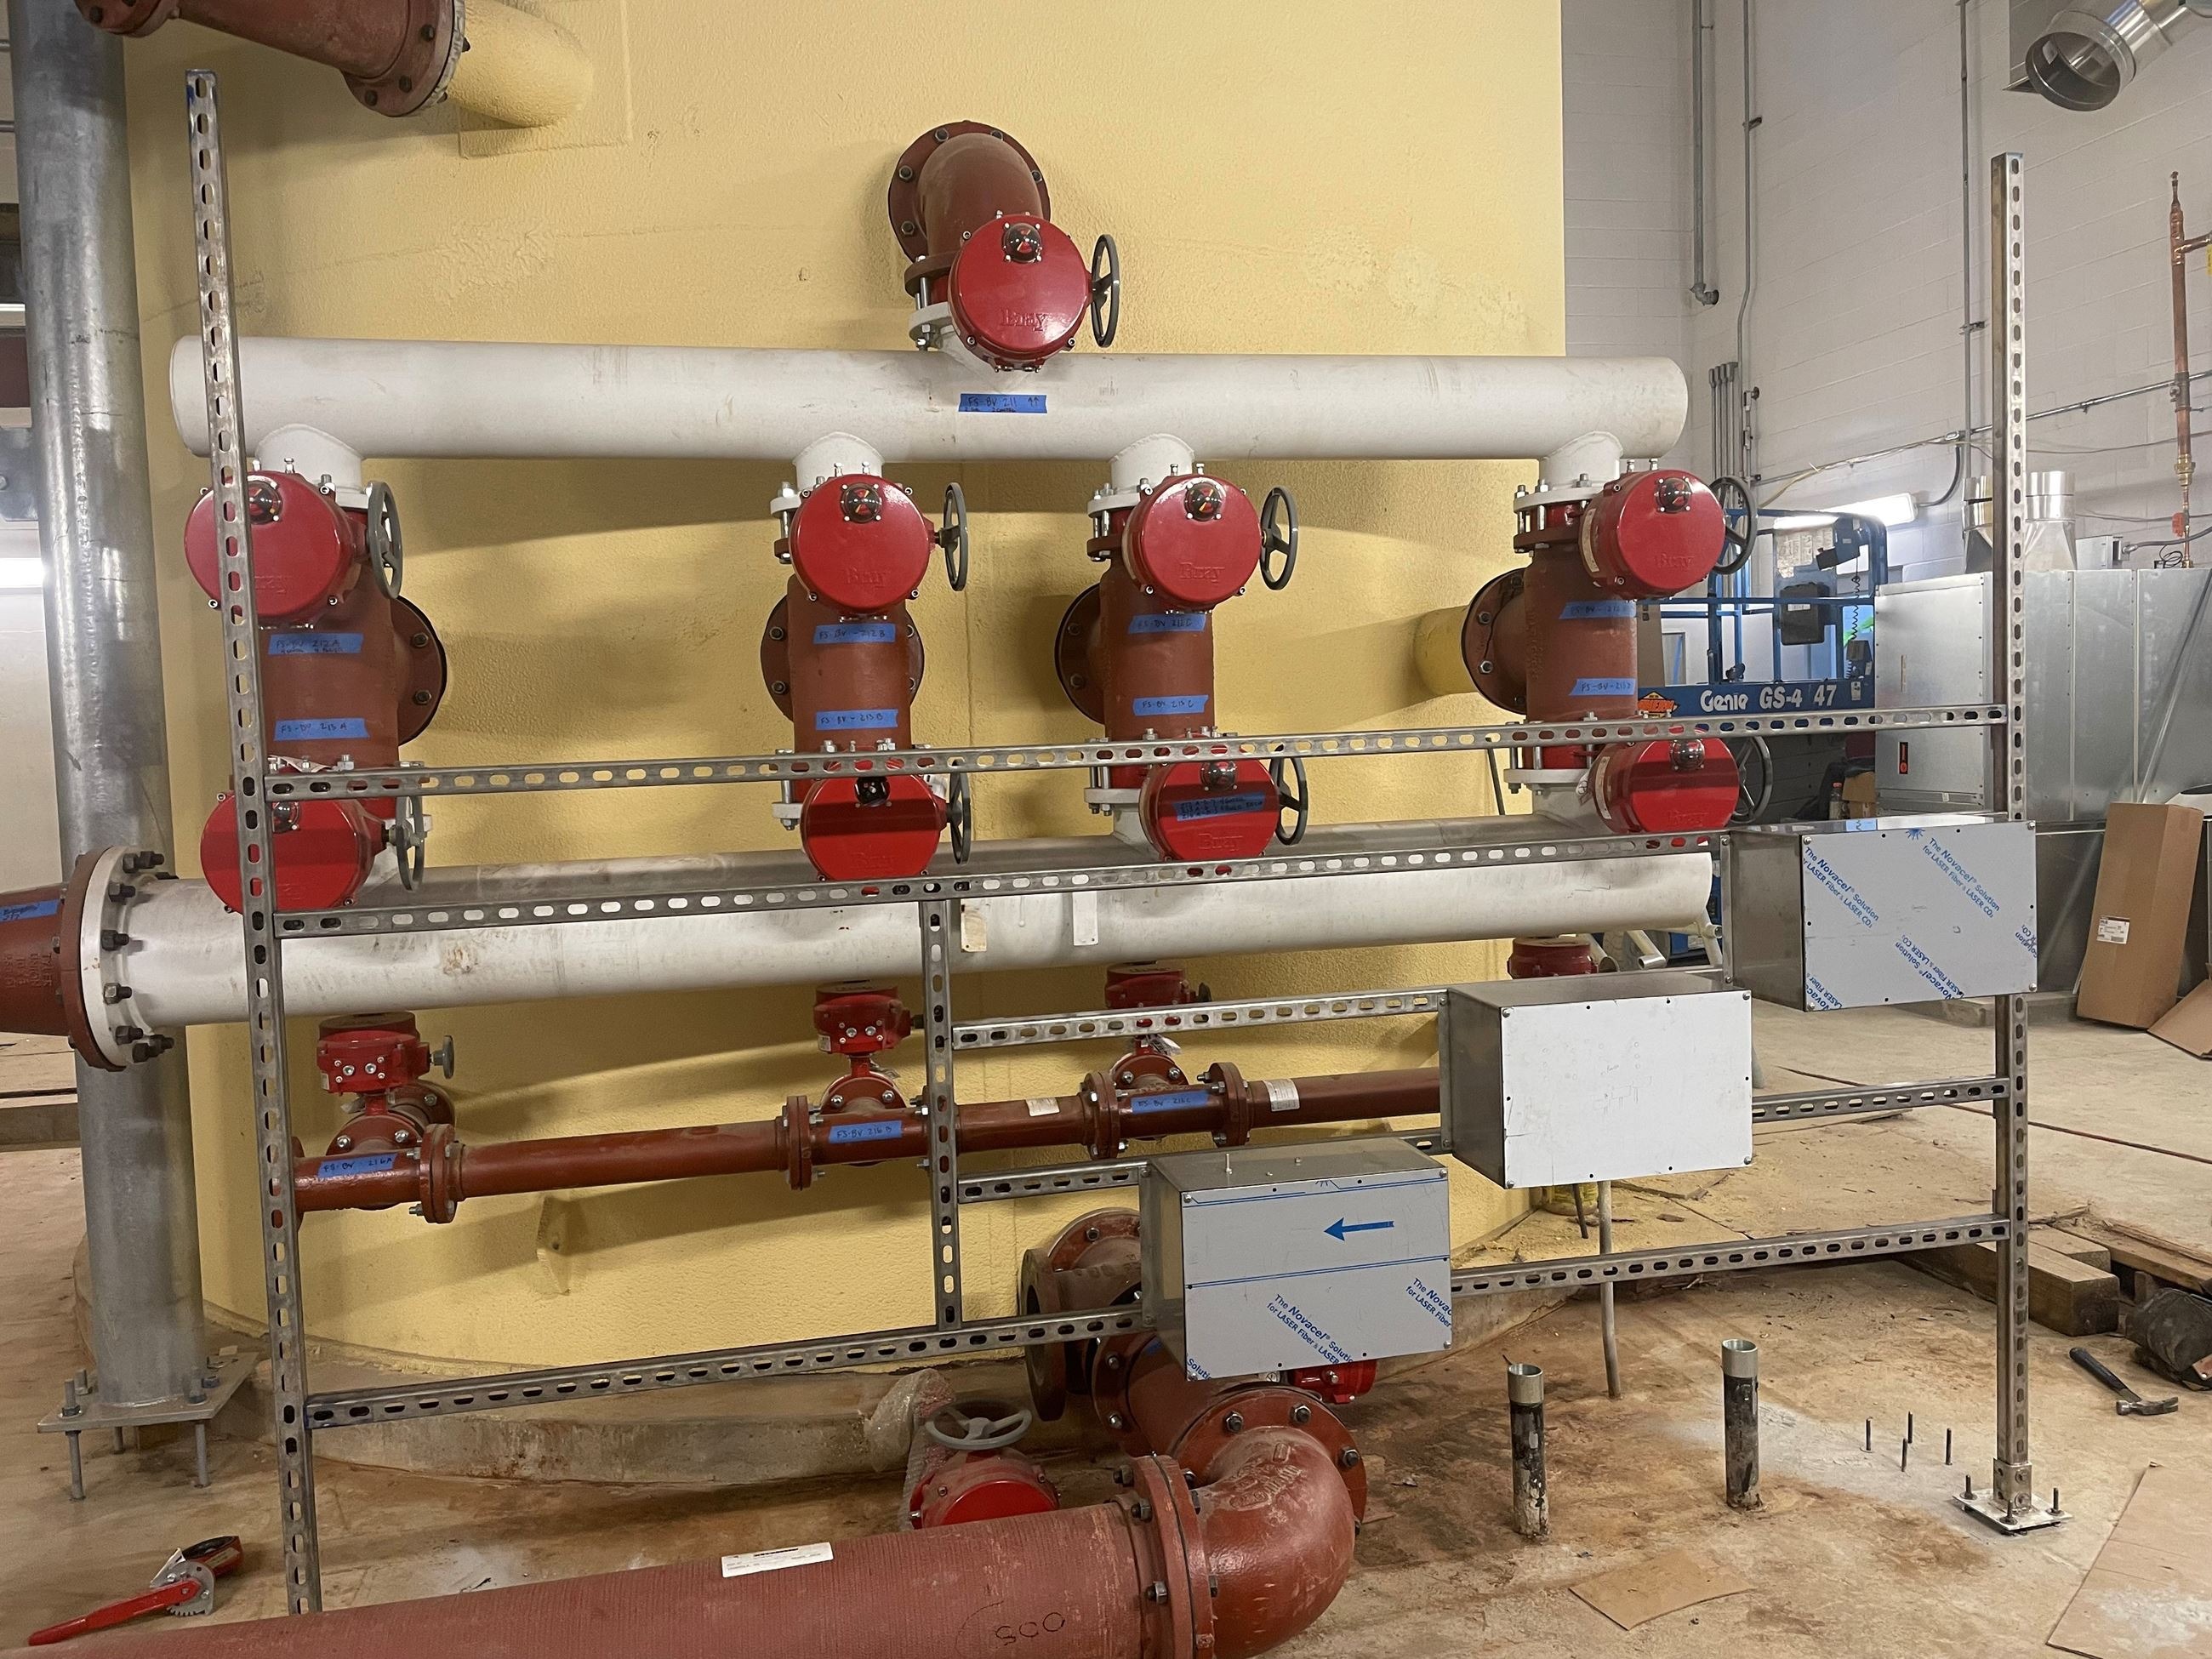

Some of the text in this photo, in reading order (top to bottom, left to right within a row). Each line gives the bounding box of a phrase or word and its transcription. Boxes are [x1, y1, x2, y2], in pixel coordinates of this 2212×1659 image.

[1701, 690, 1749, 713] Genie
[1759, 686, 1803, 710] GS-4
[1814, 684, 1838, 707] 47
[1804, 847, 1818, 862] The
[1852, 893, 1879, 921] Solution
[1923, 845, 1933, 856] for
[1930, 853, 1950, 874] LASER
[1948, 871, 1964, 887] Fiber
[1965, 889, 1985, 909] LASER
[1930, 837, 1941, 852] The
[1975, 884, 2000, 912] Solution
[1806, 863, 1827, 883] LASER
[1825, 880, 1840, 897] Fiber
[1843, 898, 1862, 918] LASER
[1895, 942, 1920, 969] Solution
[1911, 944, 1930, 965] LASER
[1809, 977, 1825, 993] Fiber
[1932, 966, 1947, 983] Fiber
[1413, 1277, 1427, 1292] The
[1274, 1293, 1289, 1309] The
[1405, 1286, 1451, 1327] for LASER Fiber
[1267, 1302, 1278, 1314] for
[1276, 1311, 1298, 1331] LASER
[1297, 1328, 1315, 1345] Fiber
[1318, 1346, 1340, 1365] LASER
